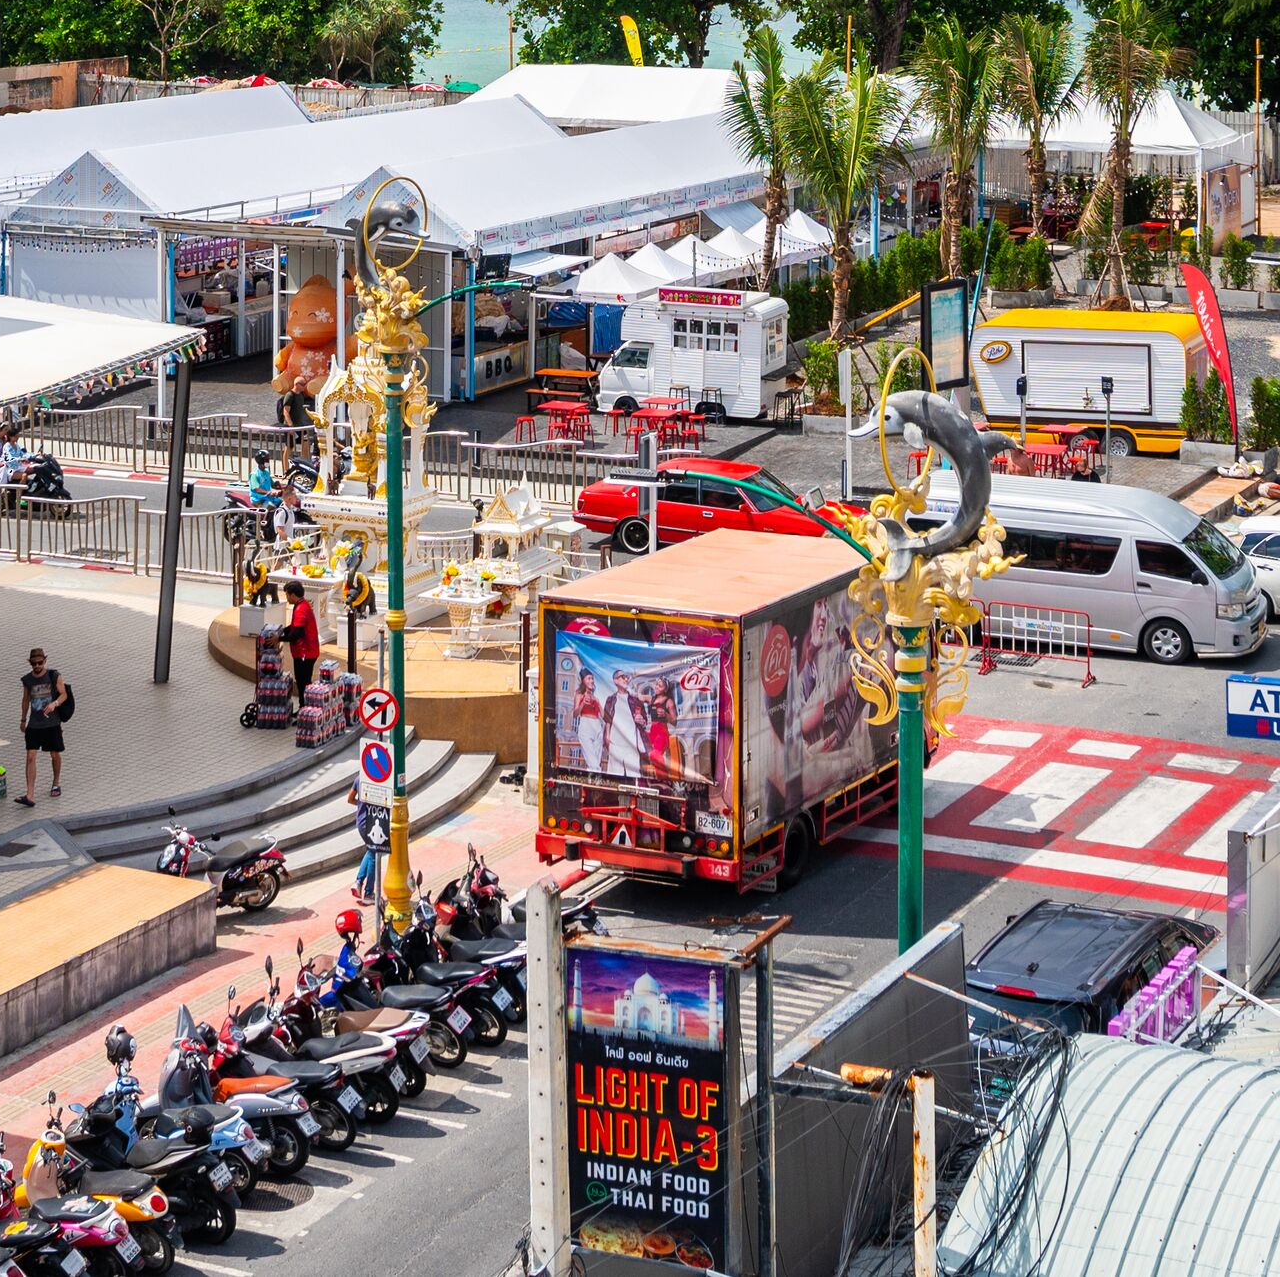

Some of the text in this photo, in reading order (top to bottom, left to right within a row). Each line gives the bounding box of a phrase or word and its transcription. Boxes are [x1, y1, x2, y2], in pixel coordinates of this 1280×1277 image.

[486, 356, 512, 379] BBQ
[366, 805, 389, 819] YOGA
[574, 1062, 720, 1121] LIGHT OF
[586, 1161, 711, 1196] INDIAN FOOD
[610, 1188, 711, 1219] THAI FOOD
